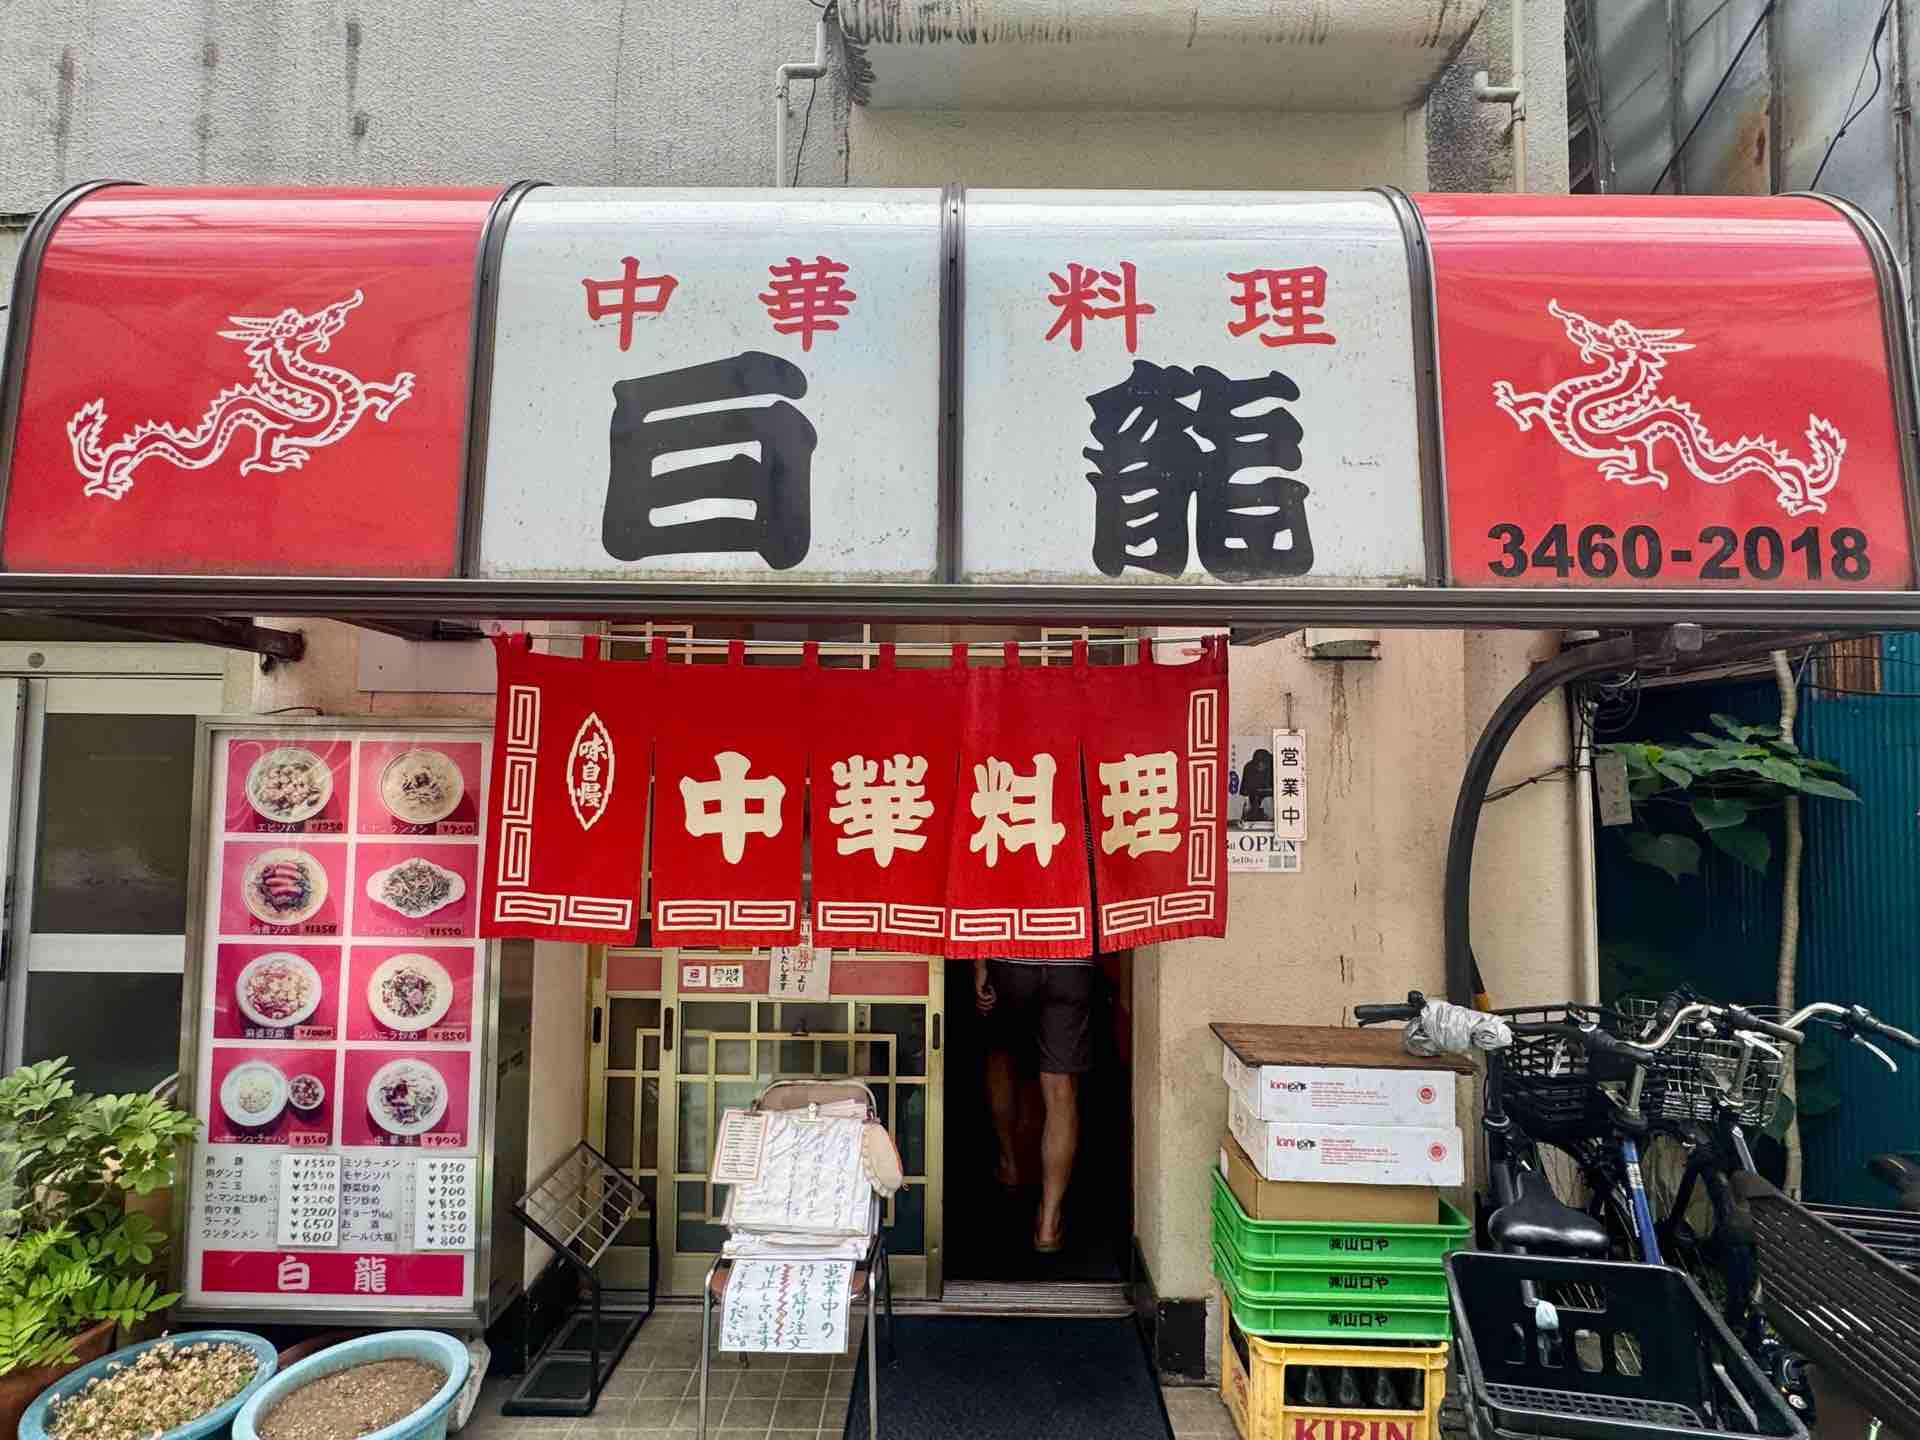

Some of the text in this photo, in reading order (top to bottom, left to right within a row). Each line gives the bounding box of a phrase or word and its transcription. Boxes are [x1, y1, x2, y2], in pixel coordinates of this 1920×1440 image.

[1487, 523, 1871, 582] 3460-2018
[576, 732, 610, 809] 味自慢
[1281, 747, 1300, 827] 営業中
[1295, 1419, 1415, 1440] KIRIN
